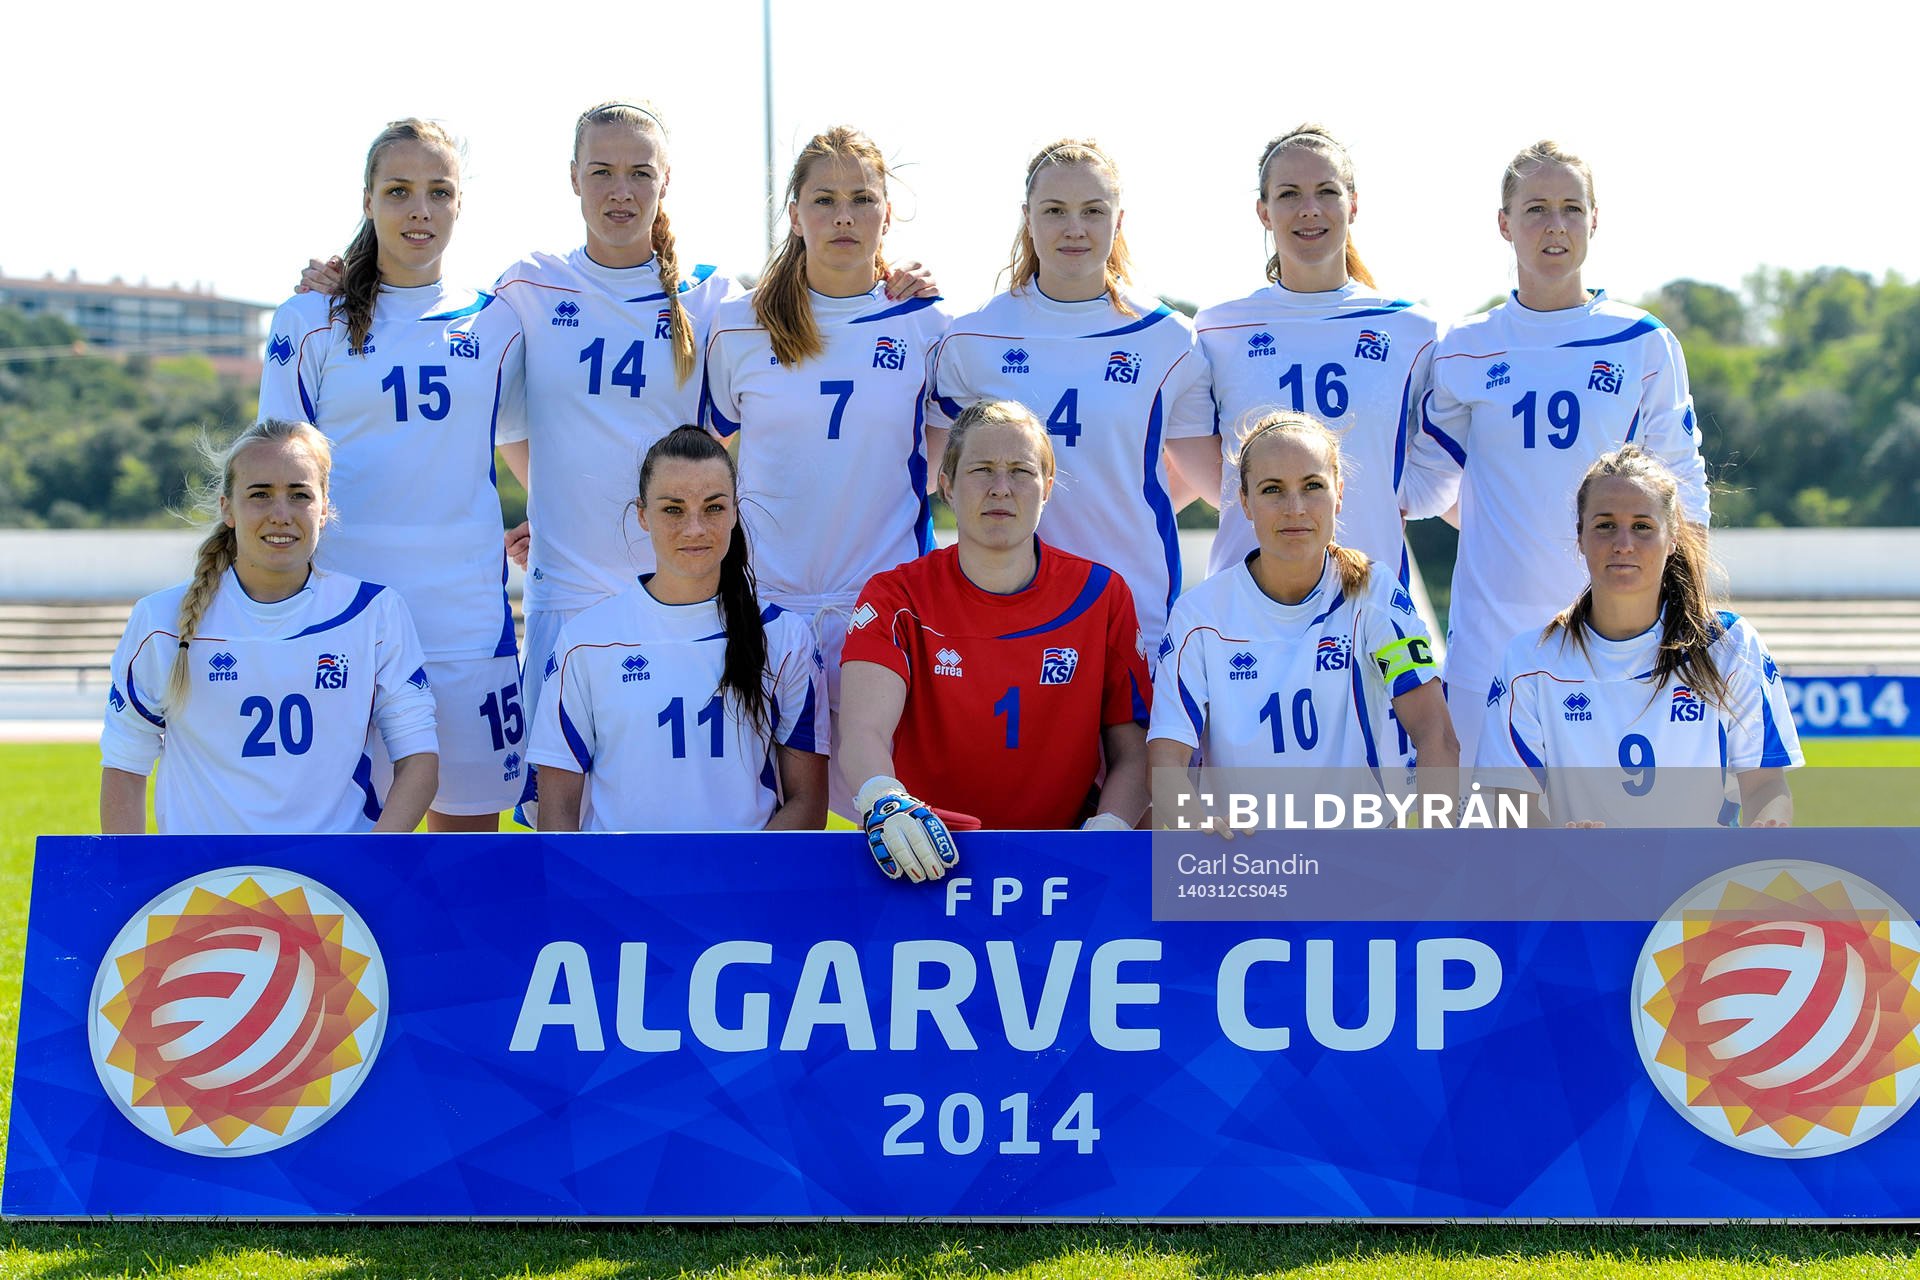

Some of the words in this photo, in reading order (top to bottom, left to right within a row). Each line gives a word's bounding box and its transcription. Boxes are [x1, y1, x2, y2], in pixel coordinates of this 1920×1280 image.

[381, 365, 451, 422] 15
[579, 337, 646, 398] 14
[1278, 362, 1349, 418] 16
[820, 379, 854, 440] 7
[1045, 388, 1082, 447] 4
[1511, 390, 1581, 449] 19
[1407, 639, 1434, 665] C
[239, 693, 313, 758] 20
[479, 682, 524, 752] 15
[657, 695, 724, 759] 11
[994, 685, 1020, 749] 1
[1259, 687, 1319, 754] 10
[1617, 733, 1656, 797] 9
[927, 819, 954, 858] SELECT
[508, 939, 1162, 1053] ALGARVE
[1216, 937, 1503, 1052] CUP
[883, 1092, 1101, 1156] 2014
